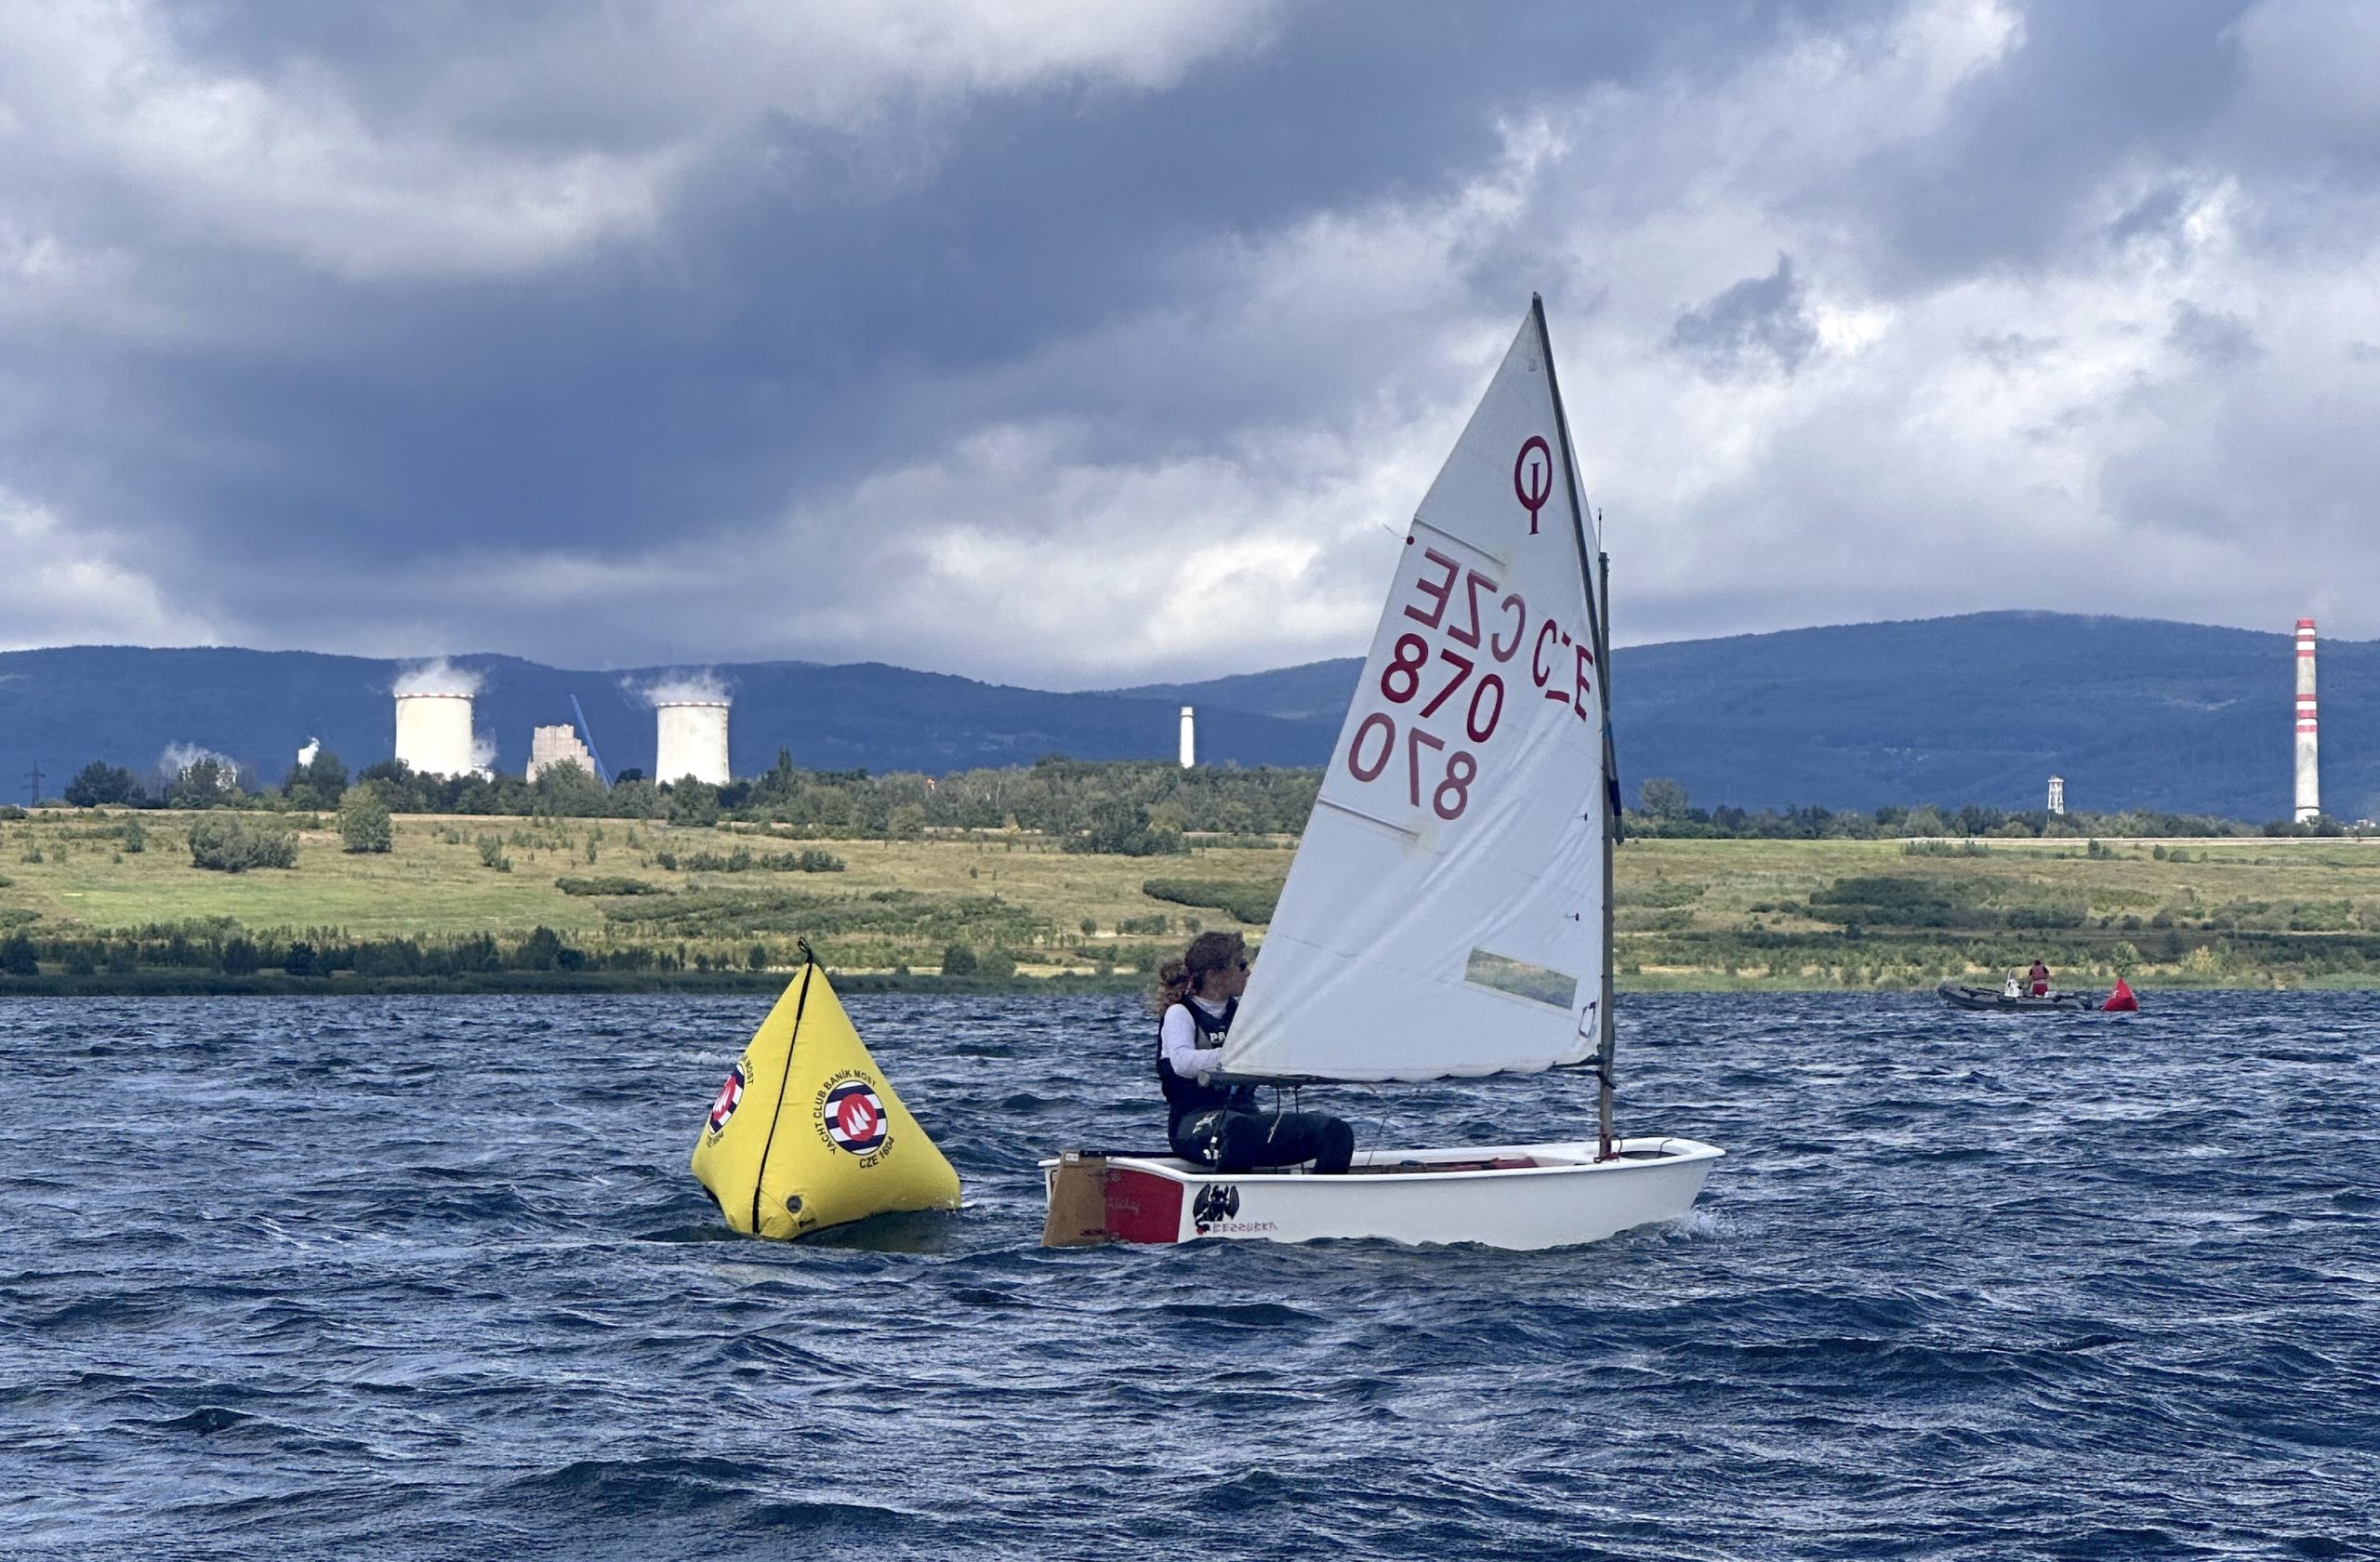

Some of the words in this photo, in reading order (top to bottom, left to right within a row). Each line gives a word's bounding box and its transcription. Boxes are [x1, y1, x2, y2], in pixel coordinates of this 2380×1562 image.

[1381, 633, 1504, 743] 870
[823, 1068, 853, 1091] BANÍK
[853, 1069, 877, 1087] MOST
[813, 1090, 827, 1119] CLUB
[814, 1121, 838, 1155] YACHT
[859, 1154, 879, 1169] CZE
[879, 1135, 894, 1159] 1604
